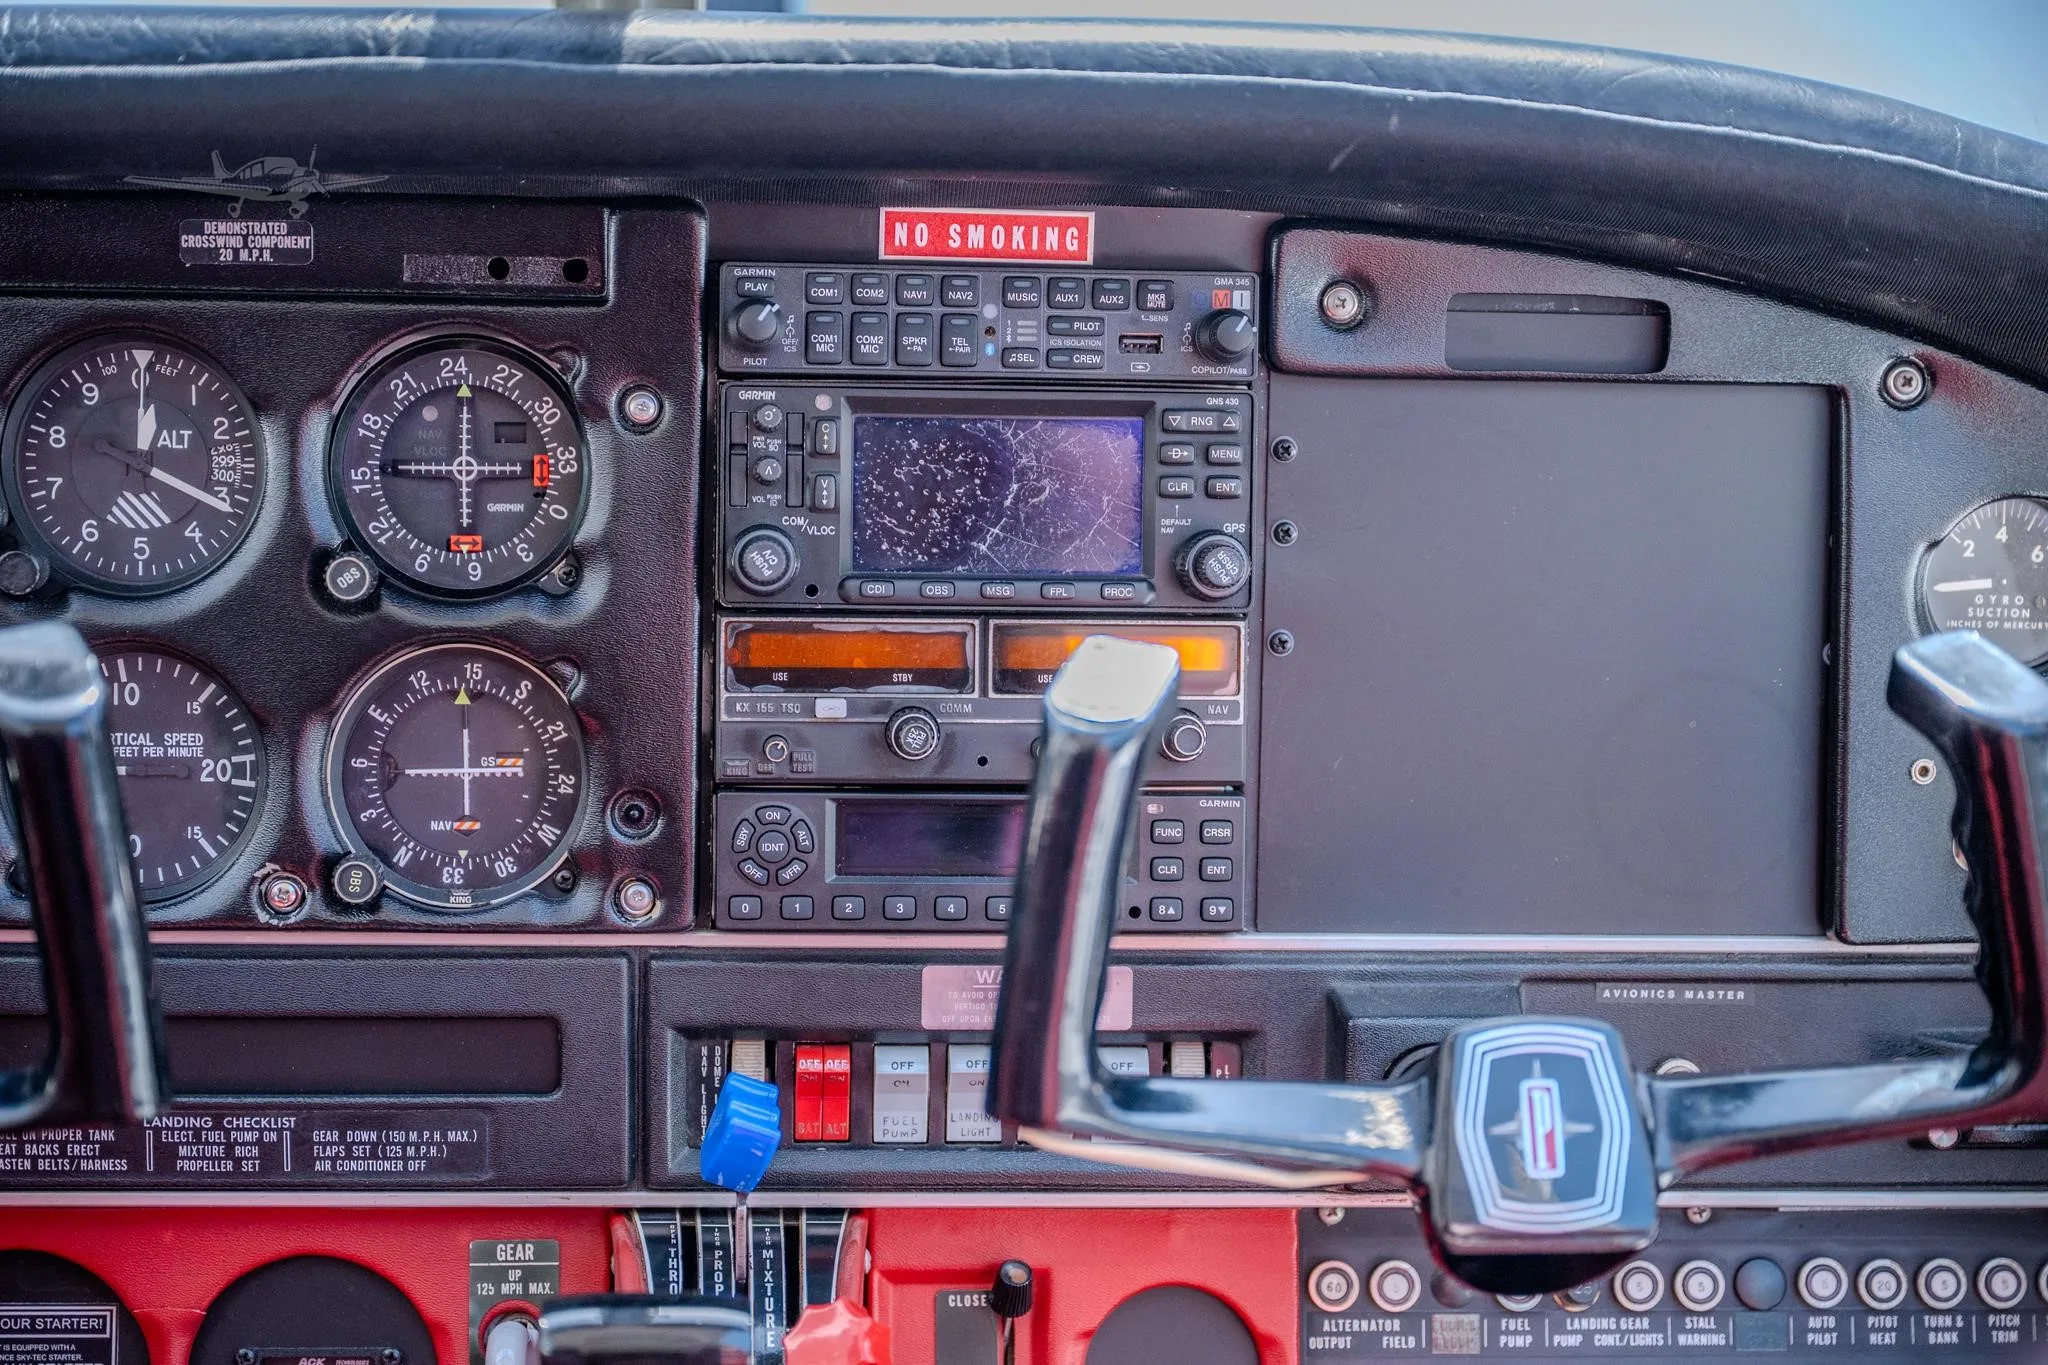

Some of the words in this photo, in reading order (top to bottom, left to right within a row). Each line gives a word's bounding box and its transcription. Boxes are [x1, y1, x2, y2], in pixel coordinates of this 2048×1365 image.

[204, 222, 287, 235] DEMONSTRATED
[181, 235, 243, 248] CROSSWIND
[248, 236, 311, 249] COMPONENT
[894, 222, 929, 247] NO
[948, 223, 1079, 252] SMOKING
[219, 249, 233, 261] 20
[240, 249, 273, 262] M.P.H.
[734, 268, 776, 277] GARMIN
[745, 283, 768, 292] PLAY
[811, 288, 838, 297] COM1
[856, 289, 884, 298] COM2
[904, 290, 927, 299] NAV1
[948, 291, 973, 300] NAV2
[1008, 292, 1038, 302] MUSIC
[1055, 293, 1079, 302] AUX1
[1100, 295, 1124, 304] AUX2
[1074, 322, 1101, 331] PILOT
[811, 334, 838, 344] COM1
[856, 335, 884, 344] COM2
[902, 336, 927, 346] SPKR
[952, 337, 969, 346] TEL
[1064, 339, 1102, 347] ISOLATION
[816, 343, 835, 353] MIC
[861, 344, 879, 353] MIC
[743, 358, 767, 366] PILOT
[1074, 355, 1101, 364] CREW
[155, 365, 178, 377] FEET
[440, 356, 468, 378] 24
[492, 364, 524, 388] 27
[390, 372, 418, 399] 21
[82, 383, 99, 405] 9
[739, 391, 776, 400] GARMIN
[534, 396, 561, 425] 30
[357, 413, 382, 439] 18
[1191, 417, 1213, 426] RNG
[214, 418, 230, 439] 2
[50, 426, 66, 448] 8
[157, 430, 192, 448] ALT
[557, 446, 578, 474] 33
[1211, 450, 1240, 459] MENU
[352, 467, 371, 494] 15
[46, 478, 63, 499] 7
[1168, 482, 1188, 492] CLR
[1216, 483, 1236, 492] ENT
[487, 503, 524, 512] GARMIN
[82, 520, 99, 542] 6
[185, 521, 203, 542] 4
[368, 516, 394, 546] 12
[1223, 523, 1245, 533] GPS
[1995, 526, 2008, 543] 4
[134, 538, 149, 559] 5
[1963, 540, 1975, 557] 2
[2031, 545, 2044, 563] 6
[1217, 551, 1239, 575] CRSR
[1208, 559, 1230, 584] PUSH
[336, 568, 361, 589] OBS
[867, 585, 885, 594] CDI
[926, 586, 949, 595] OBS
[986, 587, 1010, 595] MSG
[1050, 587, 1067, 596] FPL
[1105, 588, 1132, 597] PROC
[1975, 594, 2024, 605] GYRO
[1968, 608, 2030, 618] SUCTION
[1947, 620, 1982, 628] INCHES
[1987, 620, 2000, 628] OF
[2004, 621, 2048, 630] MERCURY
[464, 663, 483, 680] 15
[773, 673, 788, 681] USE
[893, 673, 913, 682] STBY
[408, 670, 431, 691] 12
[113, 683, 139, 705] 10
[515, 680, 532, 700] S
[187, 702, 201, 714] 15
[367, 704, 388, 722] E
[940, 703, 972, 713] COMM
[1208, 705, 1229, 715] NAV
[547, 721, 568, 742] 21
[164, 733, 203, 745] SPEED
[113, 748, 139, 757] FEET
[143, 748, 164, 757] PER
[168, 748, 203, 757] MINUTE
[481, 756, 496, 767] GS
[200, 759, 231, 782] 20
[1200, 800, 1240, 808] GARMIN
[765, 812, 780, 820] ON
[431, 820, 452, 831] NAV
[187, 826, 202, 838] 15
[1155, 828, 1182, 837] FUNC
[1204, 828, 1231, 837] CRSR
[762, 843, 784, 852] IDNT
[1158, 866, 1177, 875] CLR
[1207, 866, 1226, 875] ENT
[349, 870, 362, 893] OBS
[1603, 989, 1675, 999] AVIONICS
[1685, 990, 1745, 1000] MASTER
[891, 1062, 915, 1071] OFF
[1111, 1061, 1134, 1071] OFF
[143, 1117, 212, 1128] LANDING
[224, 1117, 296, 1128] CHECKLIST
[42, 1129, 82, 1141] PROPER
[89, 1129, 114, 1141] TANK
[161, 1131, 196, 1142] ELECT.
[202, 1131, 225, 1143] FUEL
[230, 1131, 259, 1143] PUMP
[263, 1131, 277, 1142] ON
[313, 1131, 339, 1143] GEAR
[346, 1131, 377, 1143] DOWN
[961, 1127, 992, 1137] LIGHT
[25, 1144, 60, 1156] BACKS
[67, 1144, 100, 1156] ERECT
[178, 1146, 225, 1158] MIXTURE
[235, 1146, 259, 1158] RICH
[313, 1146, 345, 1157] FLAPS
[352, 1146, 371, 1157] SET
[176, 1160, 233, 1172] PROPELLER
[241, 1160, 261, 1172] SET
[314, 1160, 331, 1172] AIR
[336, 1160, 404, 1172] CONDITIONER
[408, 1160, 427, 1172] OFF
[496, 1244, 534, 1261] GEAR
[508, 1270, 522, 1281] UP
[714, 1250, 725, 1296] PROP
[477, 1283, 494, 1295] 125
[501, 1284, 522, 1295] MPH
[529, 1284, 554, 1295] MAX.
[762, 1250, 776, 1348] MIXTURE
[35, 1318, 103, 1330] STARTER!
[1323, 1320, 1400, 1332] ALTERNATOR
[1502, 1318, 1530, 1331] FUEL
[1566, 1317, 1617, 1330] LANDING
[1620, 1318, 1650, 1330] GEAR
[1685, 1317, 1716, 1329] STALL
[1808, 1316, 1836, 1329] AUTO
[1867, 1315, 1898, 1328] PITOT
[1923, 1315, 1953, 1328] TURN
[1988, 1314, 2020, 1327] PITCH
[1383, 1337, 1415, 1348] FIELD
[1500, 1336, 1533, 1347] PUMP
[1553, 1334, 1583, 1347] PUMP
[1677, 1333, 1726, 1346] WARNING
[1807, 1333, 1838, 1346] PILOT
[1869, 1333, 1897, 1345] HEAT
[1928, 1332, 1959, 1344] BANK
[1991, 1330, 2018, 1343] TRIM
[12, 1344, 50, 1352] EQUIPPED
[1309, 1337, 1352, 1349] OUTPUT
